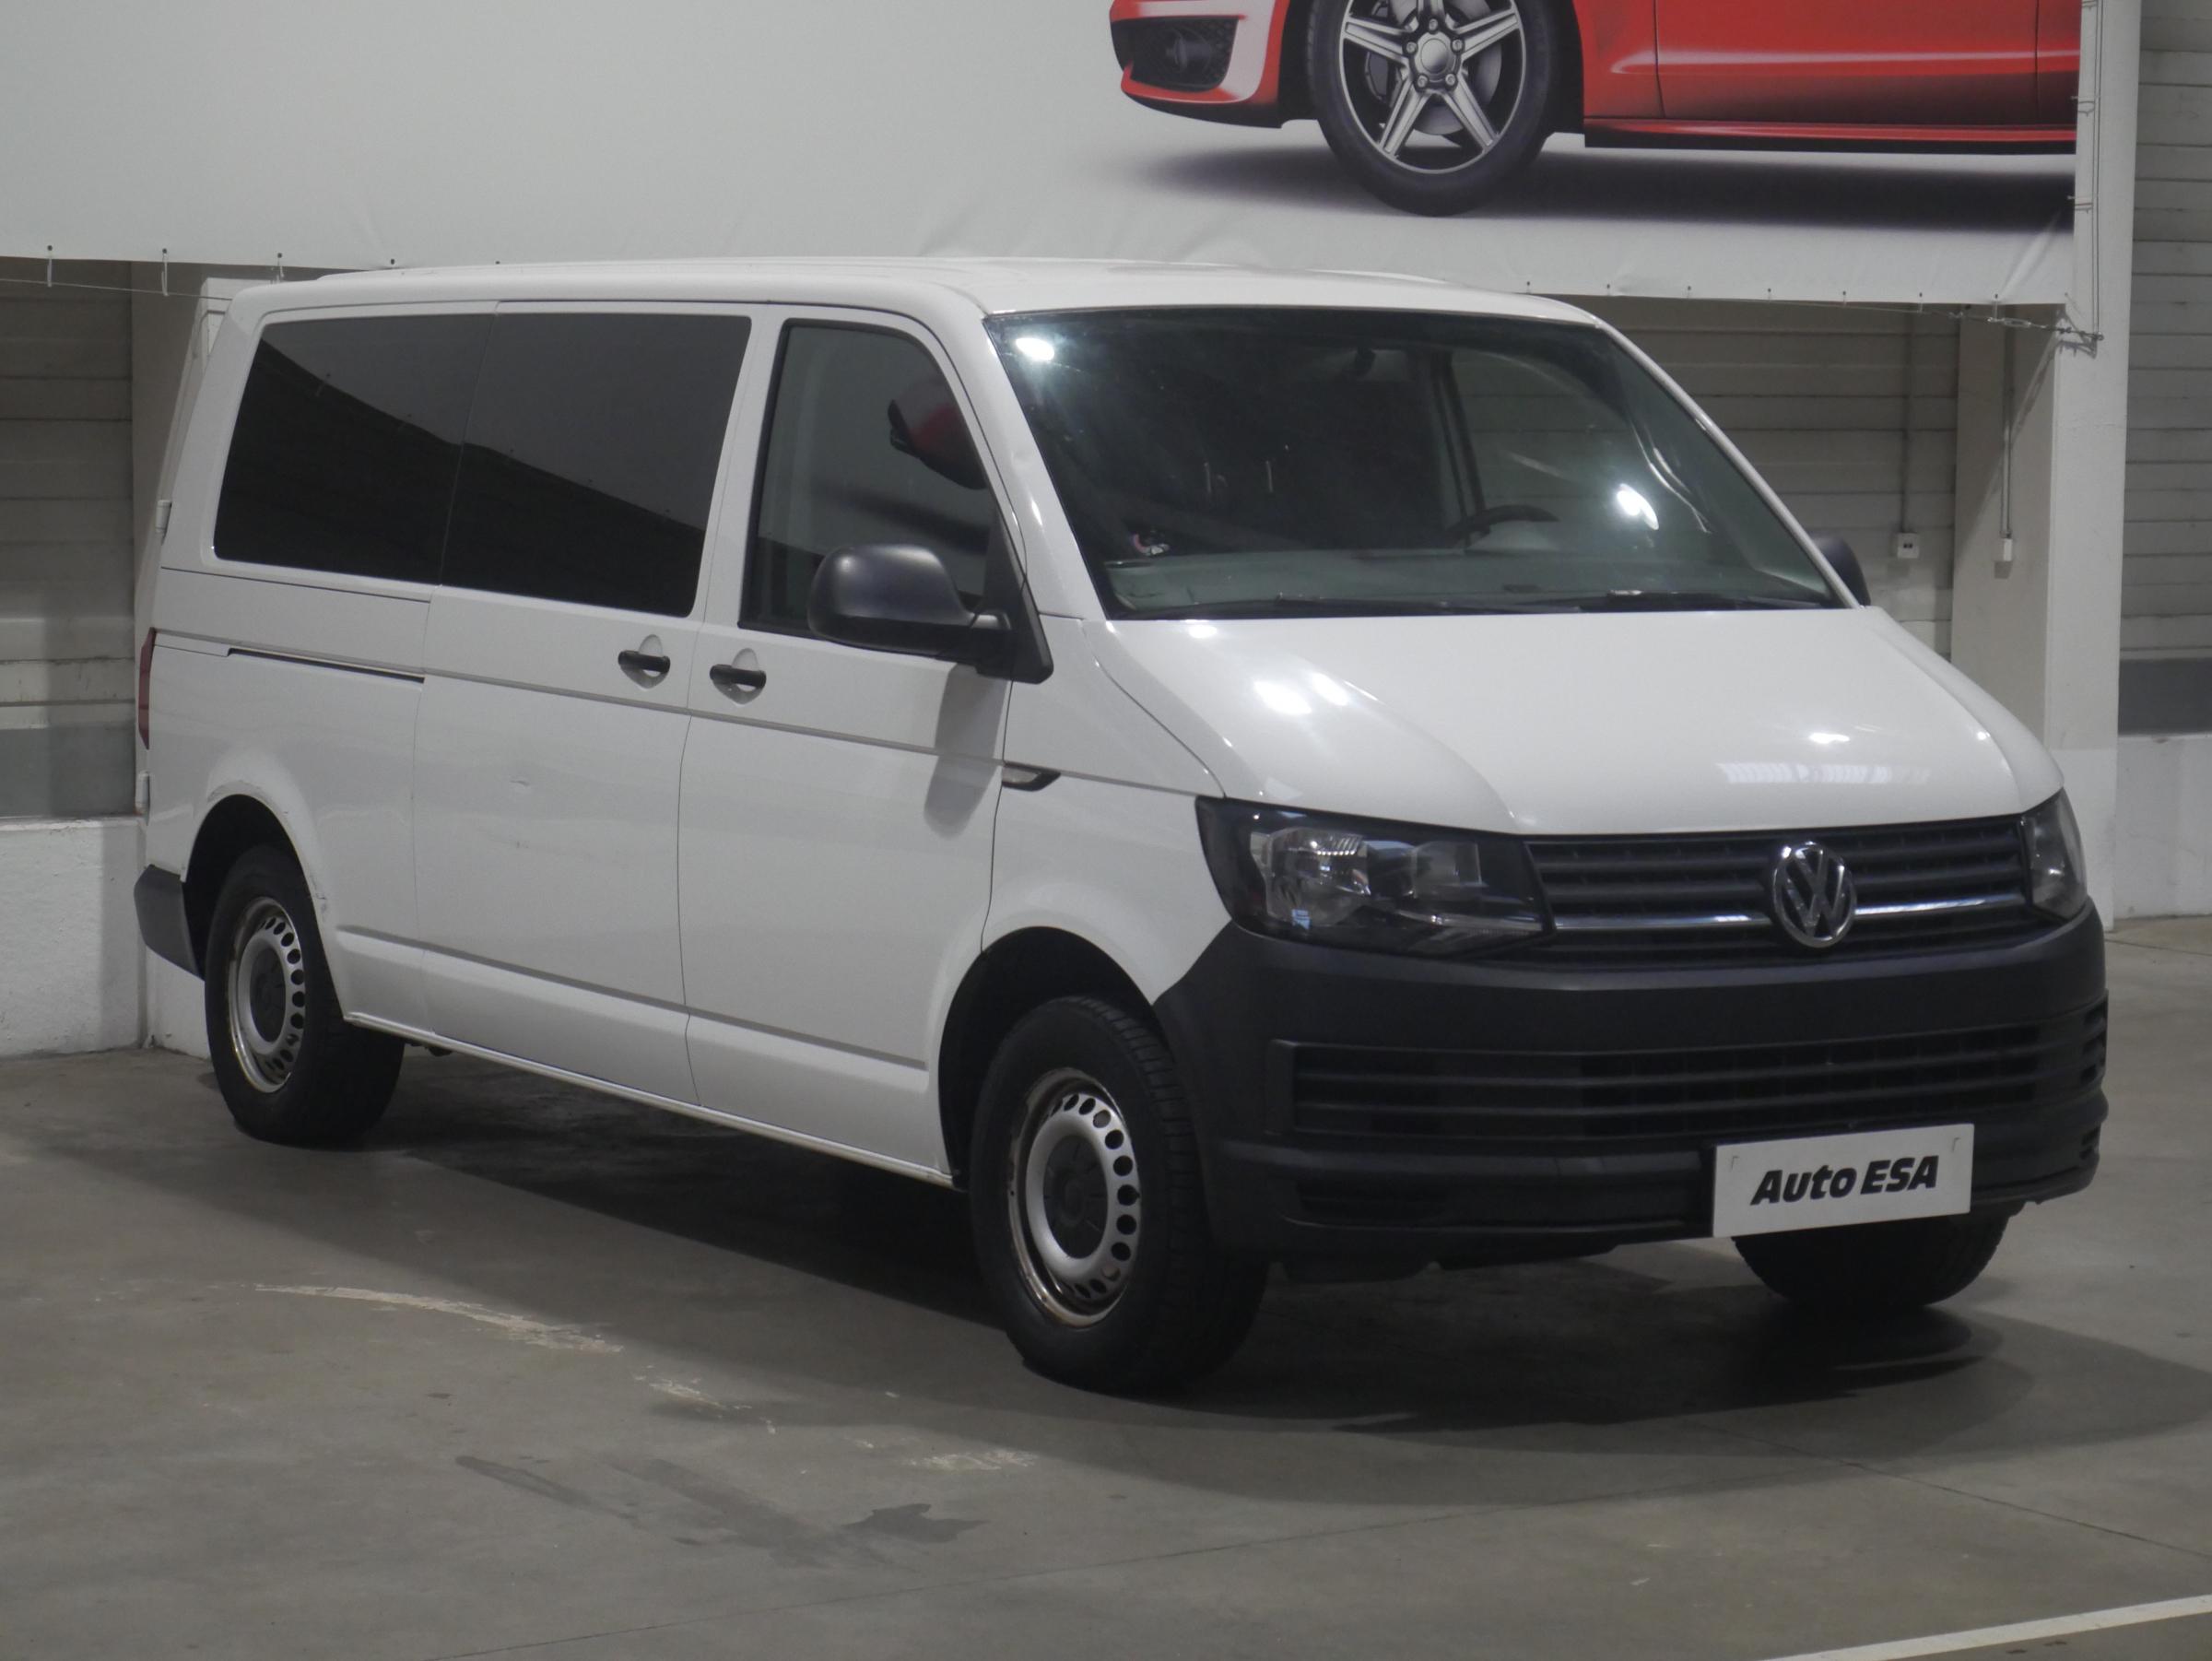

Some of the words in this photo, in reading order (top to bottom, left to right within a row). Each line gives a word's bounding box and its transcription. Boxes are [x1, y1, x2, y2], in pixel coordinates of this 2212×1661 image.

[1774, 843, 1852, 944] VW
[1749, 1164, 1858, 1207] Auto
[1859, 1154, 1940, 1196] ESA
